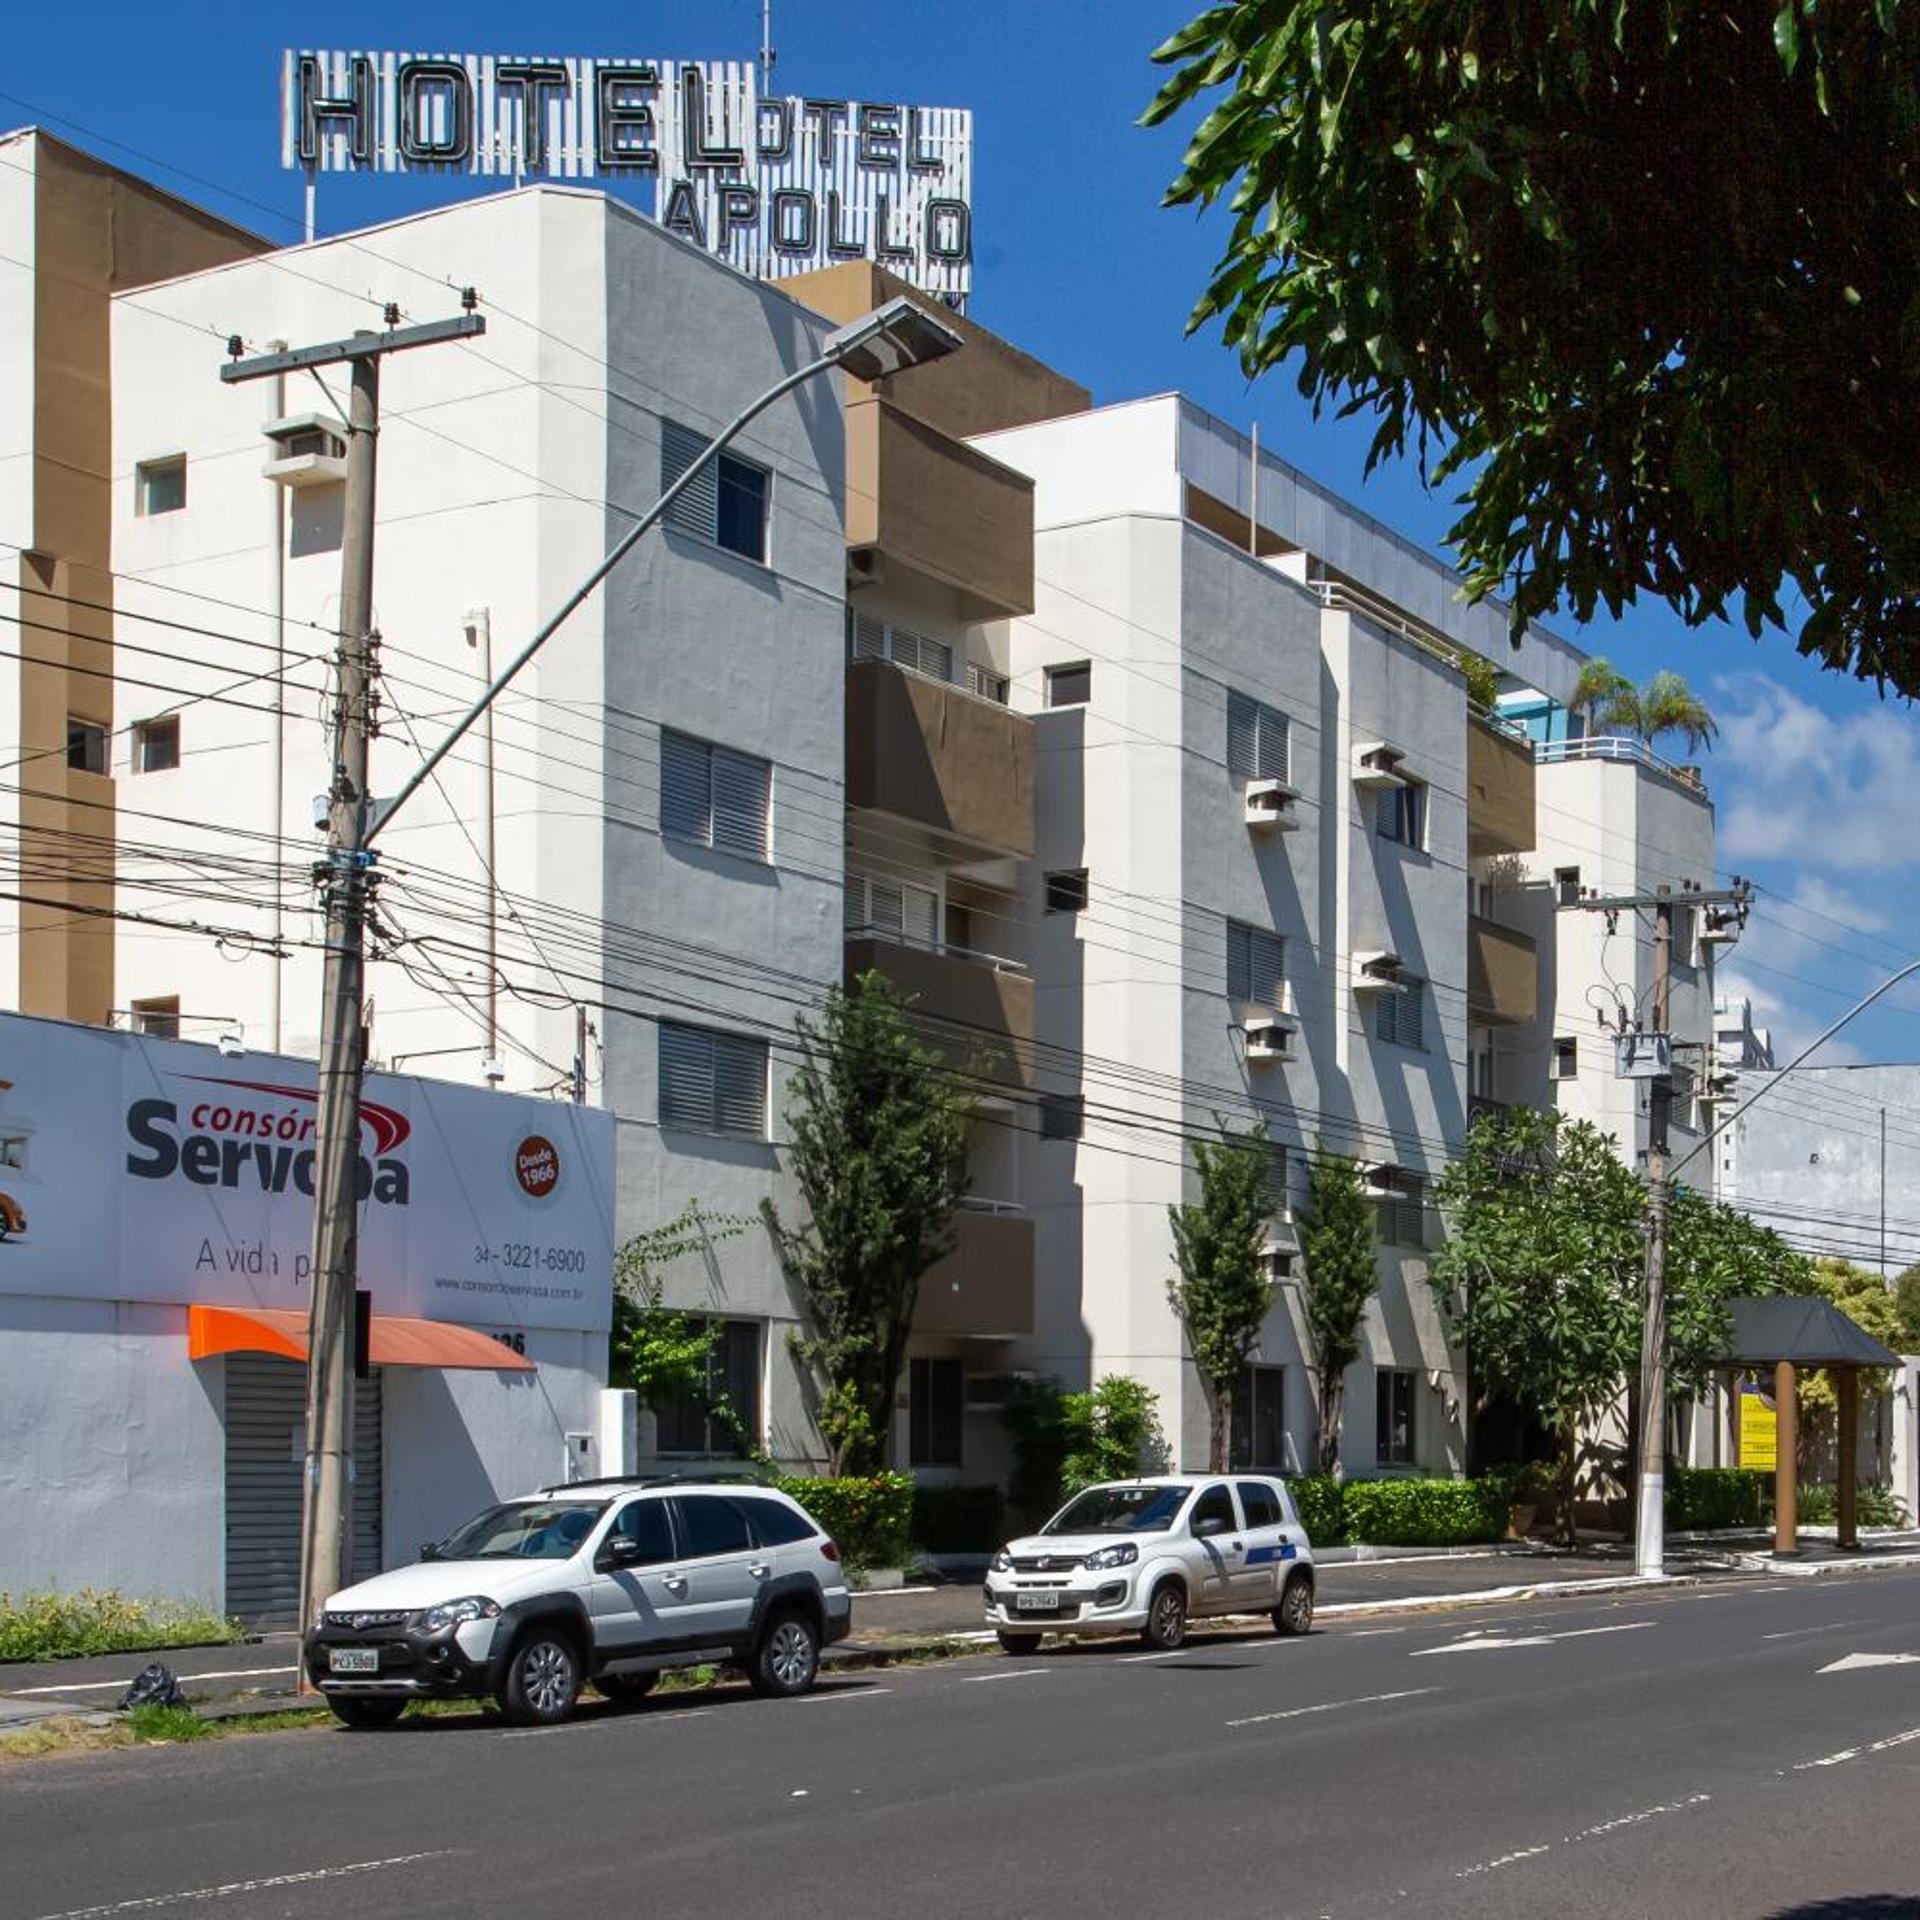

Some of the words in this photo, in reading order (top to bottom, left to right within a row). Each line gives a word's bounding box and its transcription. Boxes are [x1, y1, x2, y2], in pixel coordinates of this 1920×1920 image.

[299, 56, 744, 167] HOTEL
[660, 179, 971, 261] APOLLO
[523, 1165, 555, 1187] 1966
[195, 1239, 217, 1272] A
